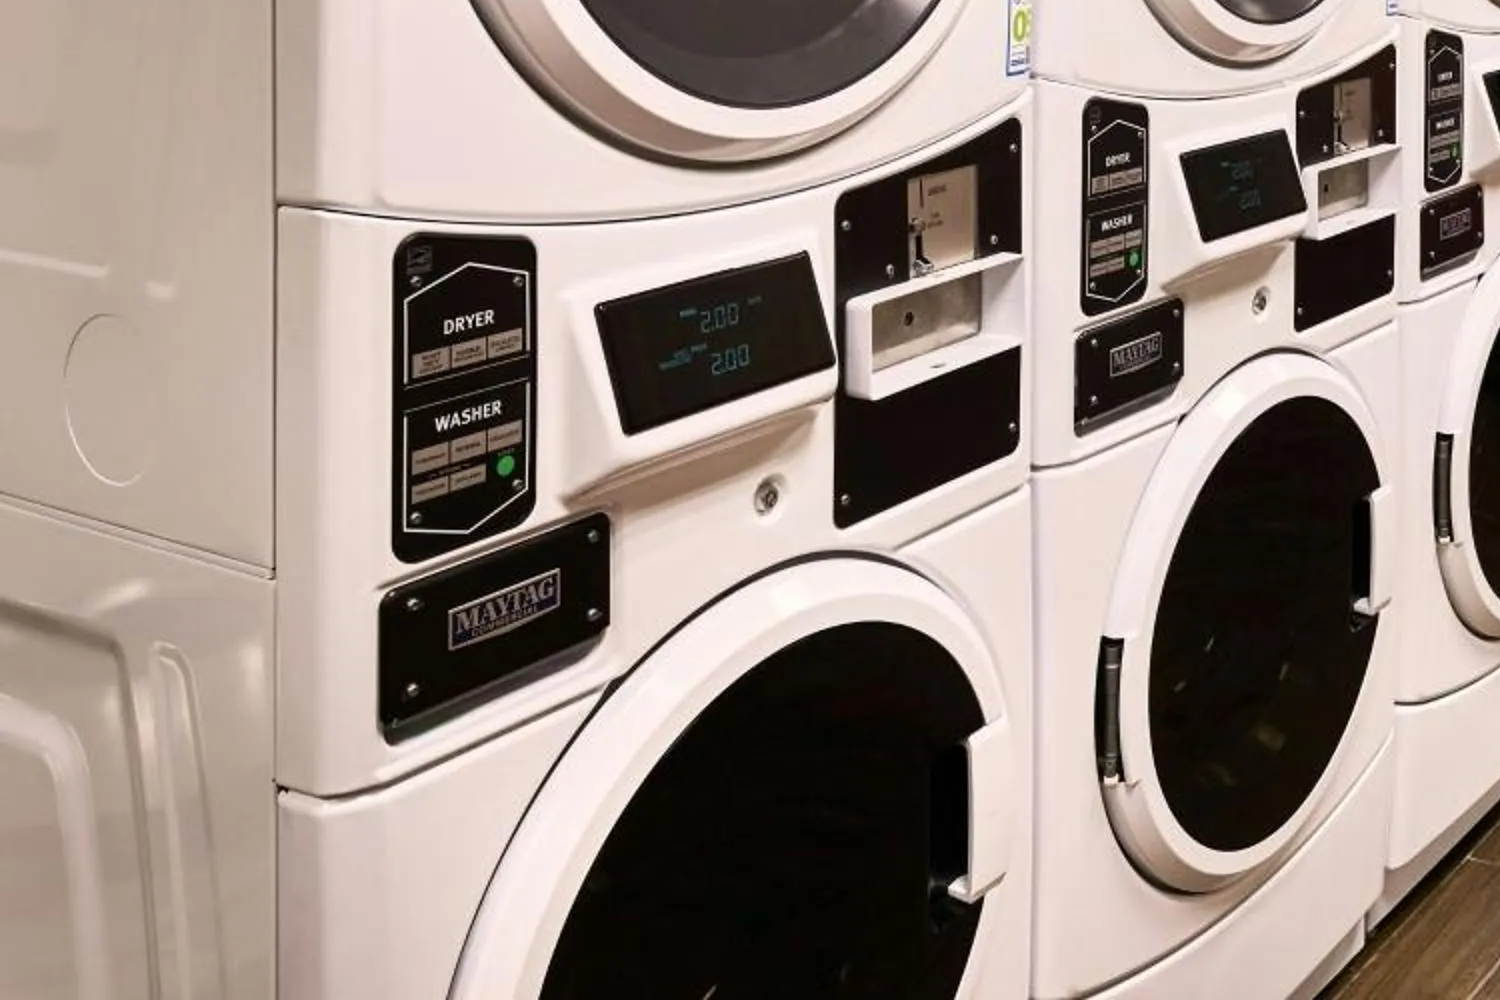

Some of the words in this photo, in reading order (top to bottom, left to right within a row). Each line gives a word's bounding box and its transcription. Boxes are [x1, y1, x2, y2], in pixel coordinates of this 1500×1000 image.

[443, 309, 495, 335] DRYER
[435, 400, 502, 432] WASHER
[456, 577, 555, 634] MAYTAG
